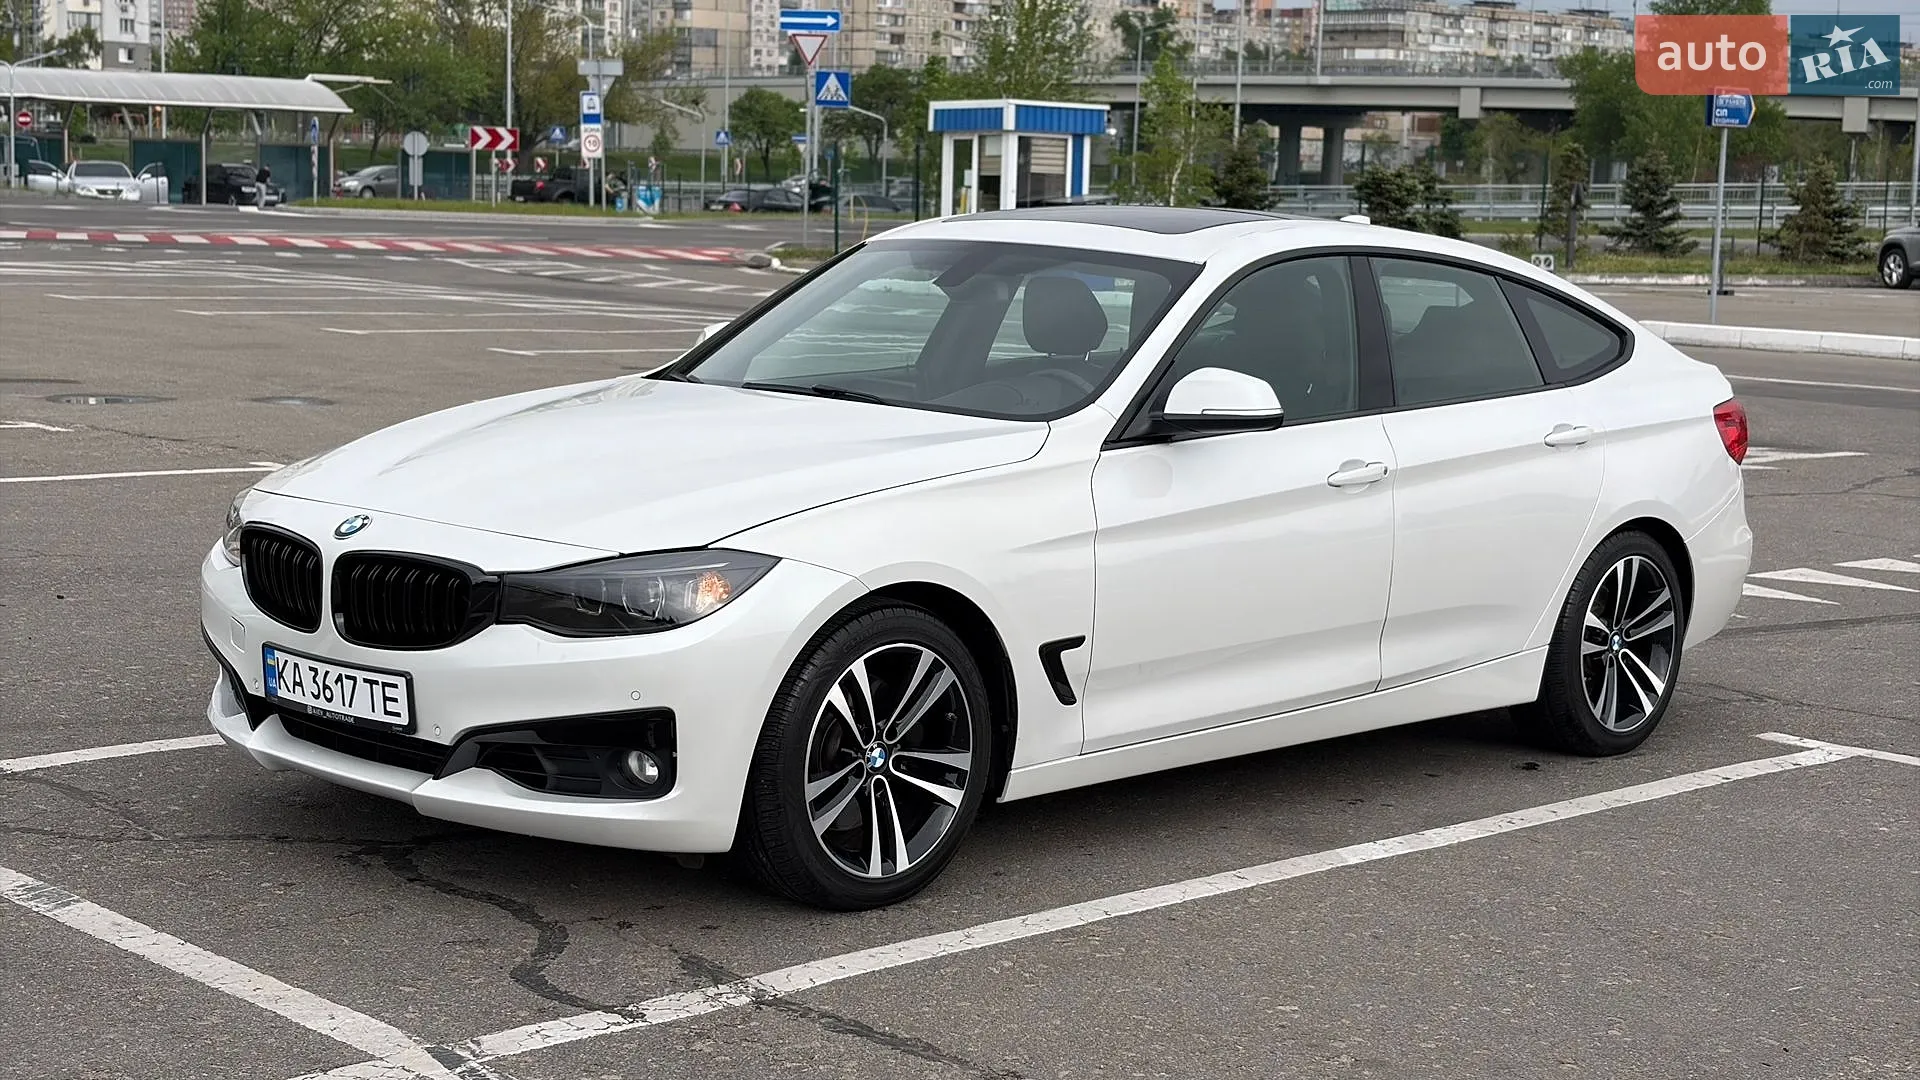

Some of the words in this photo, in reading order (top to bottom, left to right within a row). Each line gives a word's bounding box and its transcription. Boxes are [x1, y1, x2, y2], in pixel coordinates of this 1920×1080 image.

[588, 139, 597, 147] 10
[268, 677, 277, 688] UA
[276, 657, 306, 697] KA
[308, 666, 358, 709] 3617
[363, 677, 401, 718] TE
